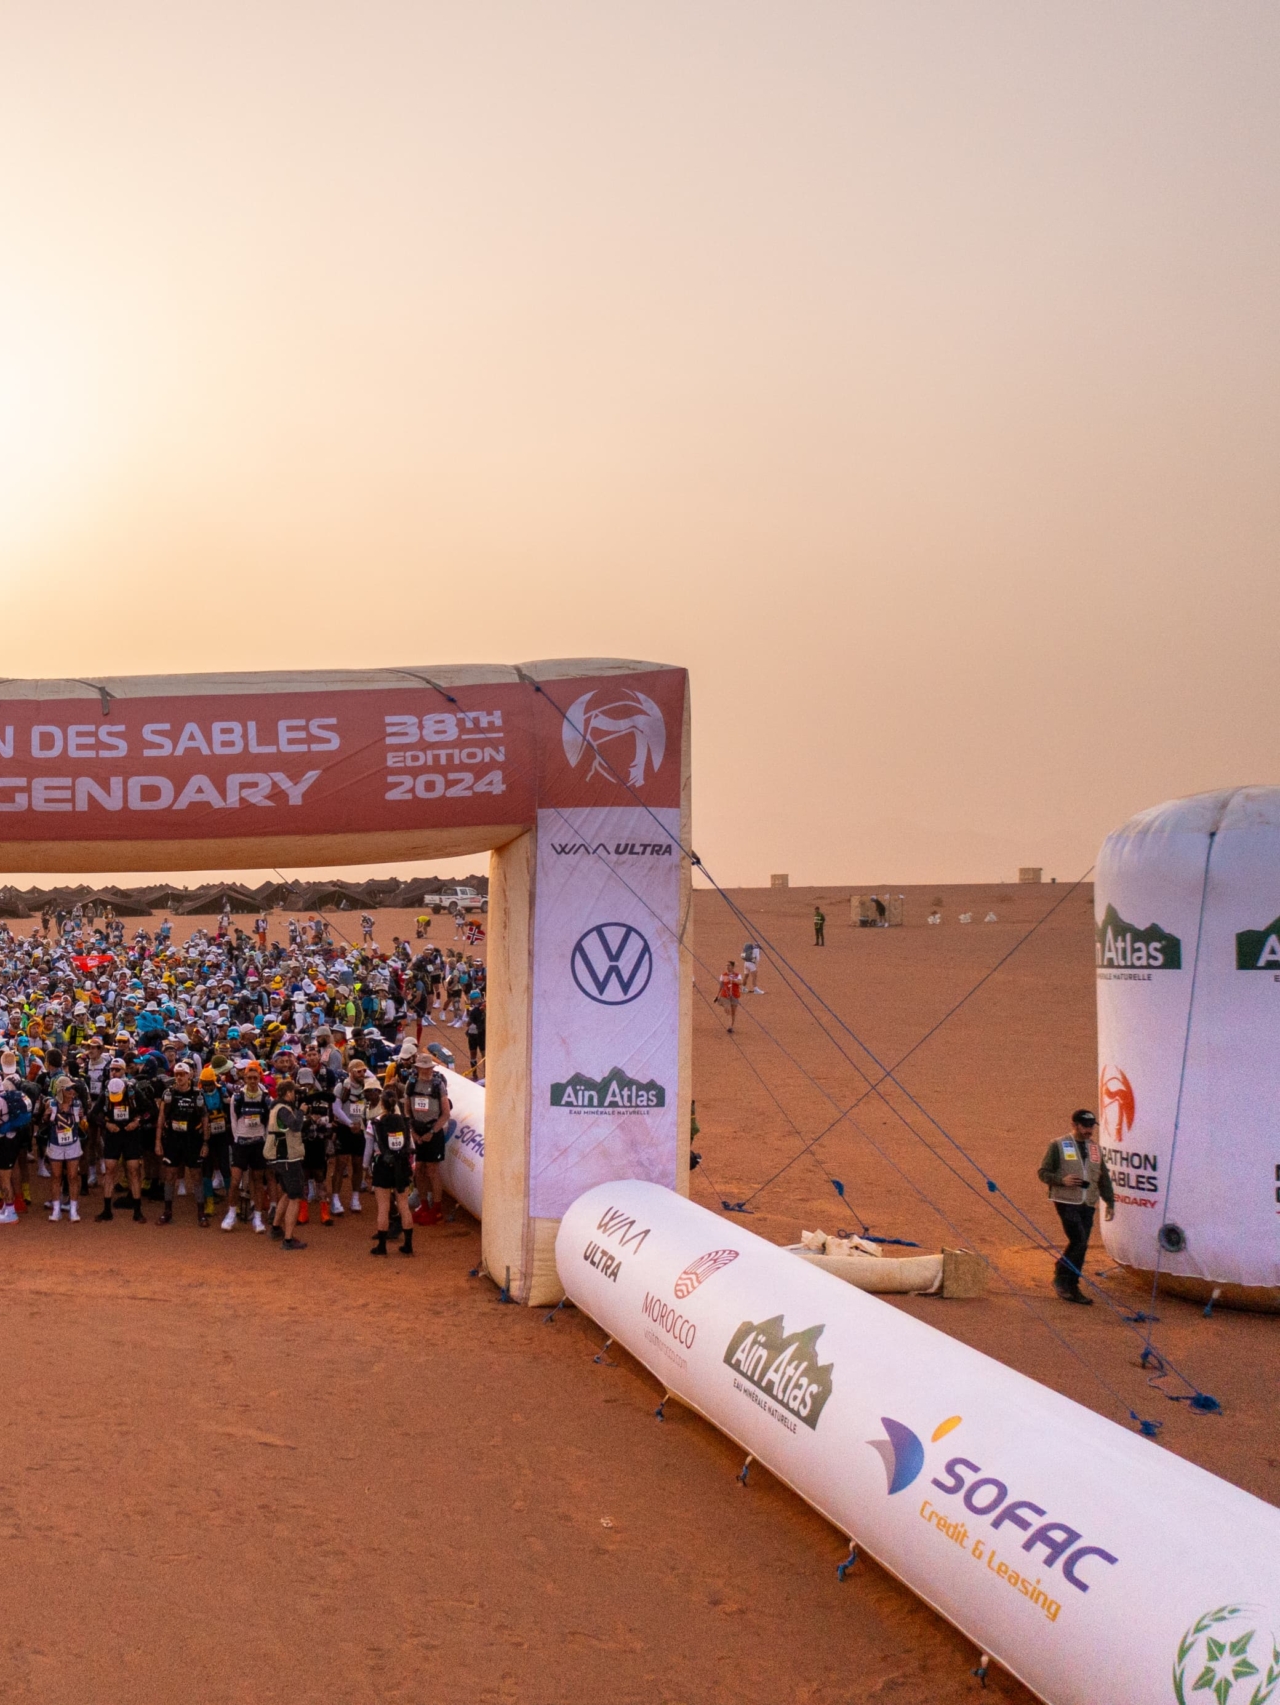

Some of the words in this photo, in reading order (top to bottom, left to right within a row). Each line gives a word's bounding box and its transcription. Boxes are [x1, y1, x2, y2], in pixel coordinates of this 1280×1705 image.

[31, 725, 128, 758] DES
[142, 718, 340, 757] SABLES
[385, 710, 503, 744] 38TH
[387, 747, 505, 767] EDITION
[385, 770, 506, 800] 2024
[614, 843, 672, 856] ULTRA
[1104, 925, 1164, 967] Atlas
[561, 1085, 598, 1106] Aïn
[604, 1080, 657, 1107] Atlas
[1102, 1147, 1157, 1172] RATHON
[1111, 1169, 1158, 1192] ABLES
[583, 1240, 622, 1283] ULTRA
[642, 1292, 696, 1349] MOROCCO
[731, 1331, 768, 1381] Aïn
[761, 1342, 818, 1417] Atlas
[733, 1378, 744, 1393] EAU
[743, 1385, 767, 1411] MINÉRALE
[767, 1405, 798, 1434] NATURELLE
[930, 1457, 1119, 1593] SOFAC
[920, 1500, 969, 1549] Crédit
[987, 1550, 1062, 1622] Leasing
